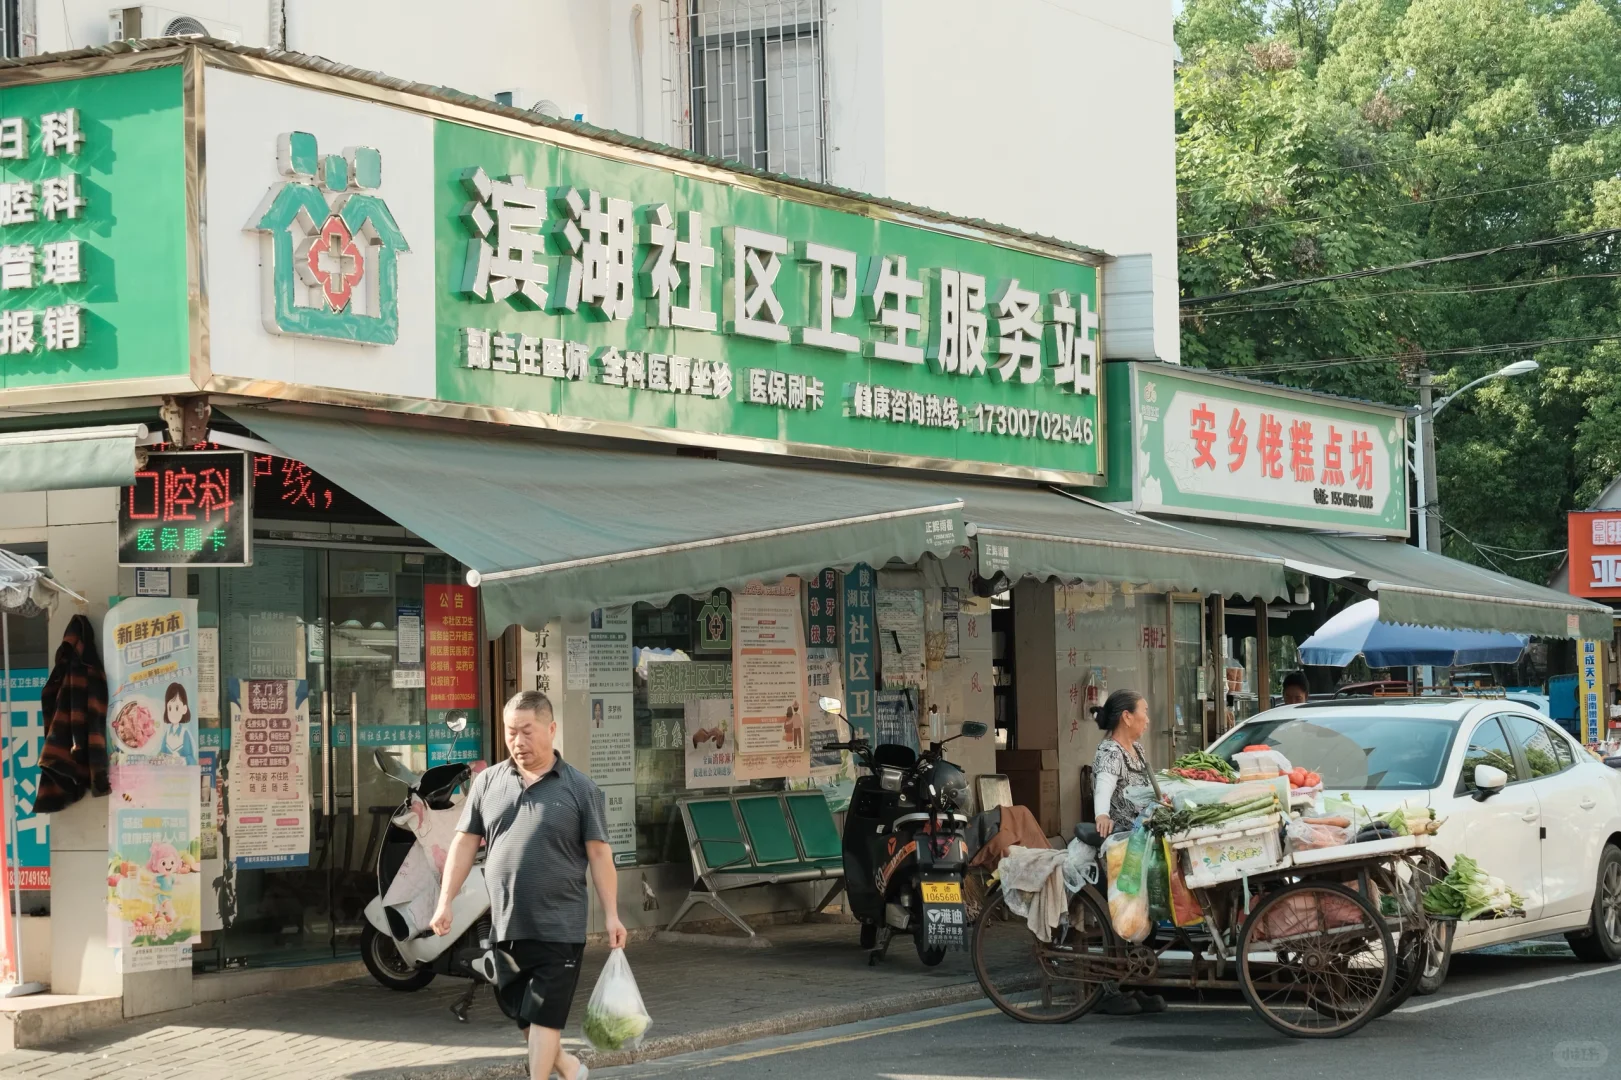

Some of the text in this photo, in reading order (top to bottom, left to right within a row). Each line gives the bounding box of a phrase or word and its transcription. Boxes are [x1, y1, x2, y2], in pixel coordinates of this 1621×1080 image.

[0, 240, 86, 290] 管理
[461, 163, 1099, 397] 滨湖社区卫生服务站
[0, 304, 86, 355] 报销
[466, 326, 589, 381] 副主任医师
[600, 345, 733, 399] 全科医师坐诊
[749, 368, 824, 411] 医保刷卡
[1190, 402, 1374, 491] 安乡佬糕点坊
[130, 467, 234, 522] 口腔科
[137, 527, 227, 551] 医保刷卡
[439, 592, 464, 608] 公告
[809, 597, 836, 616] 补牙
[117, 614, 181, 645] 新鲜为本
[442, 616, 474, 626] 本社区卫生
[430, 630, 474, 642] 服务站已开通武
[810, 624, 836, 643] 拔牙
[535, 628, 551, 693] 疗保障
[1584, 641, 1596, 690] 和成天下
[252, 683, 284, 696] 本门诊
[252, 697, 284, 710] 特色治疗
[249, 771, 268, 782] 不输液
[925, 892, 960, 902] 1065680
[931, 885, 952, 893] 常德
[940, 908, 964, 925] 雅迪
